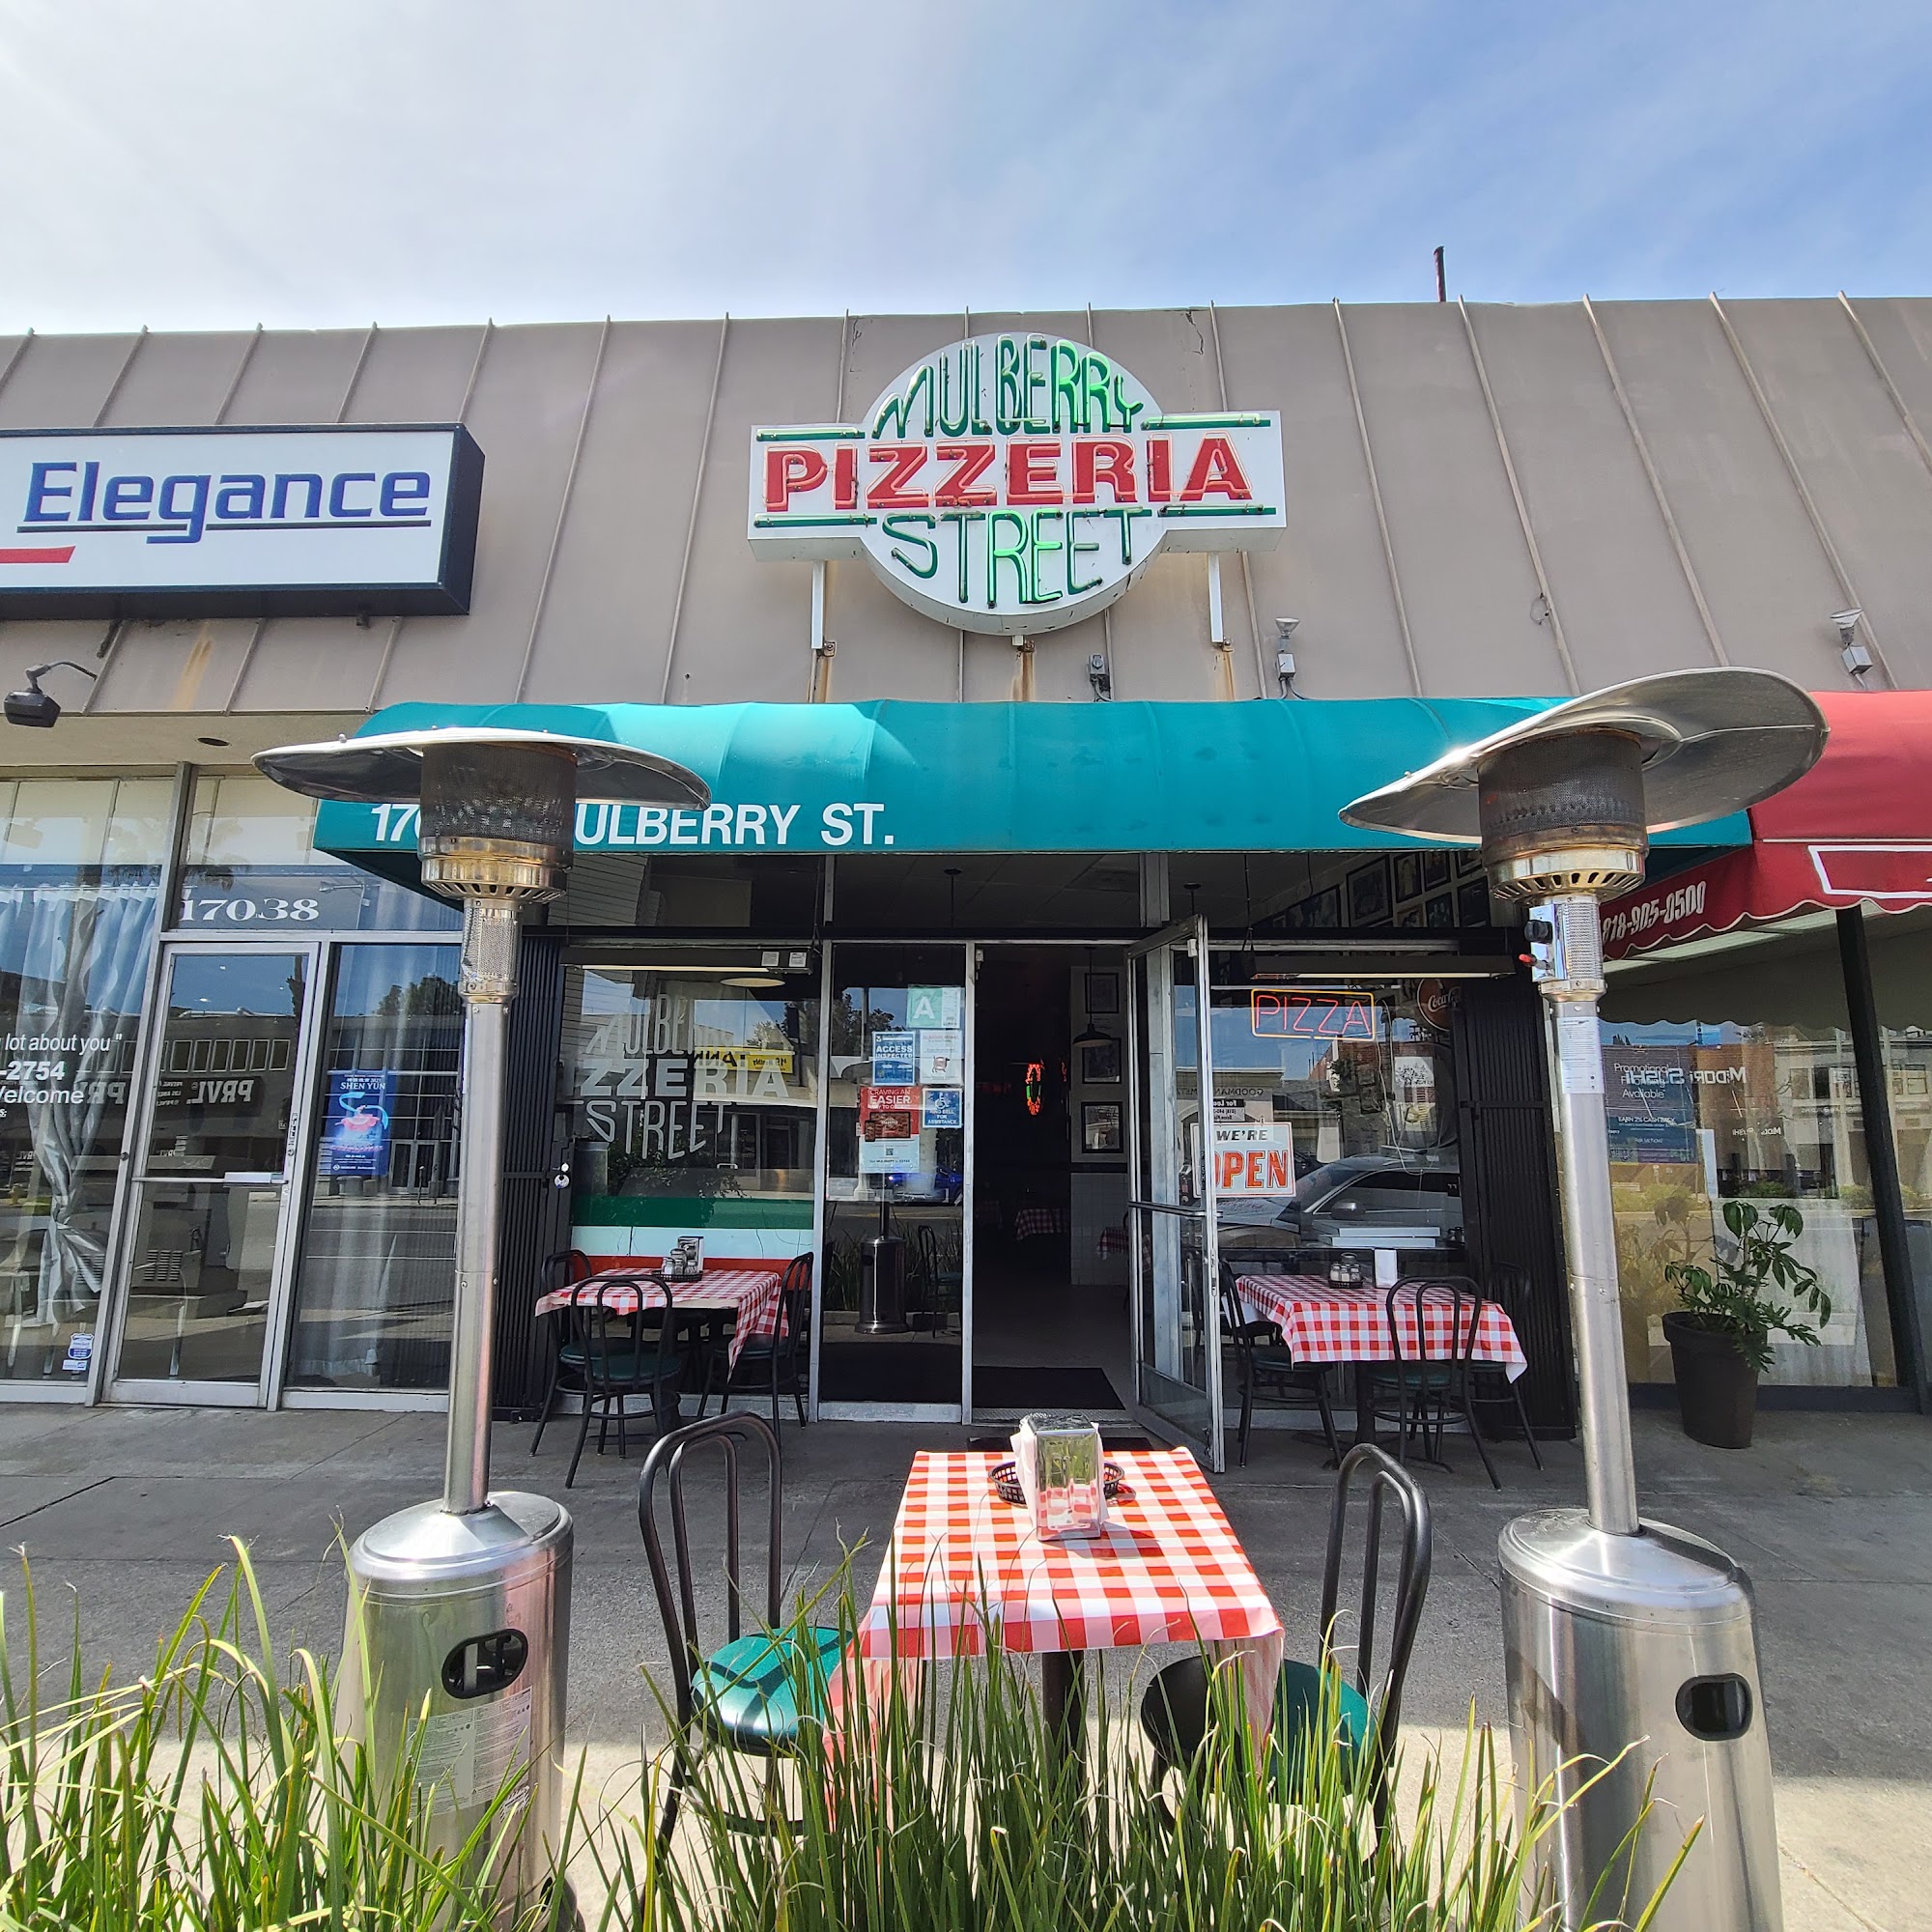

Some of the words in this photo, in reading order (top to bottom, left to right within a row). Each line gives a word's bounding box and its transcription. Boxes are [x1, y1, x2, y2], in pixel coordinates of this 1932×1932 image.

[872, 332, 1144, 439] MULBERRY
[763, 432, 1253, 512] PIZZERIA
[23, 460, 431, 545] Elegance
[881, 506, 1153, 609] STREET
[370, 802, 421, 842] 17
[575, 803, 802, 846] ULBERRY
[820, 803, 895, 846] ST.
[179, 897, 320, 922] 17038
[1603, 880, 1707, 944] 818-905-0500
[913, 996, 936, 1019] A
[1255, 994, 1373, 1036] PIZZA
[5, 1033, 27, 1051] lot
[28, 1033, 77, 1051] about
[0, 1085, 85, 1104] elcome
[340, 1081, 365, 1091] SHEN
[366, 1081, 386, 1091] YUN
[869, 1094, 911, 1105] EASIER
[585, 1099, 733, 1160] STREET
[1216, 1129, 1268, 1141] WE'RE
